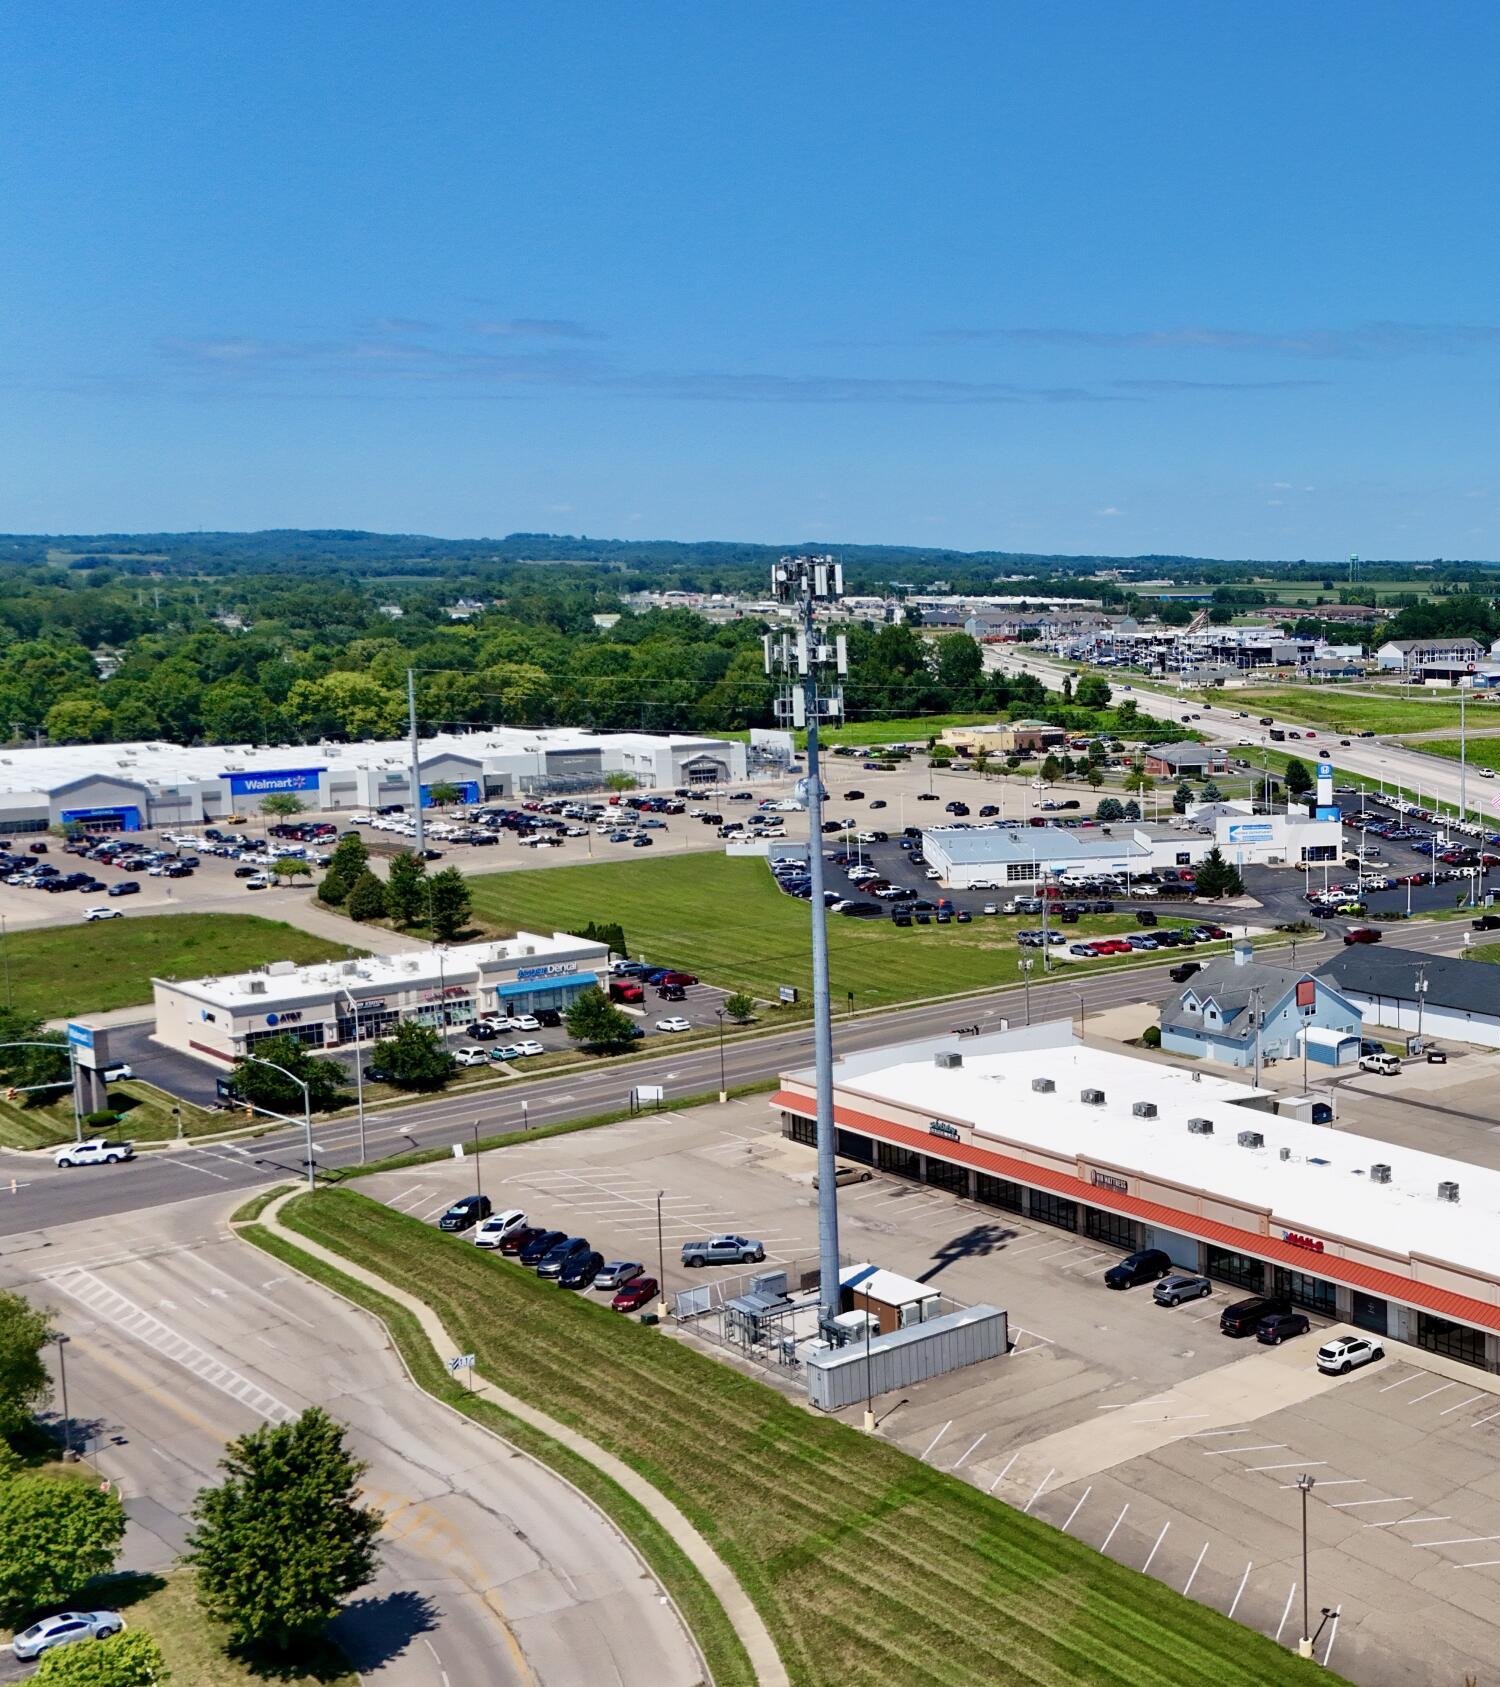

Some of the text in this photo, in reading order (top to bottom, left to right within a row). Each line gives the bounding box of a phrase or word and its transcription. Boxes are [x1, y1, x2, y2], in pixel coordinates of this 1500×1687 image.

[244, 778, 292, 790] Walmart
[547, 961, 577, 974] Dental
[280, 1011, 302, 1024] AT&T
